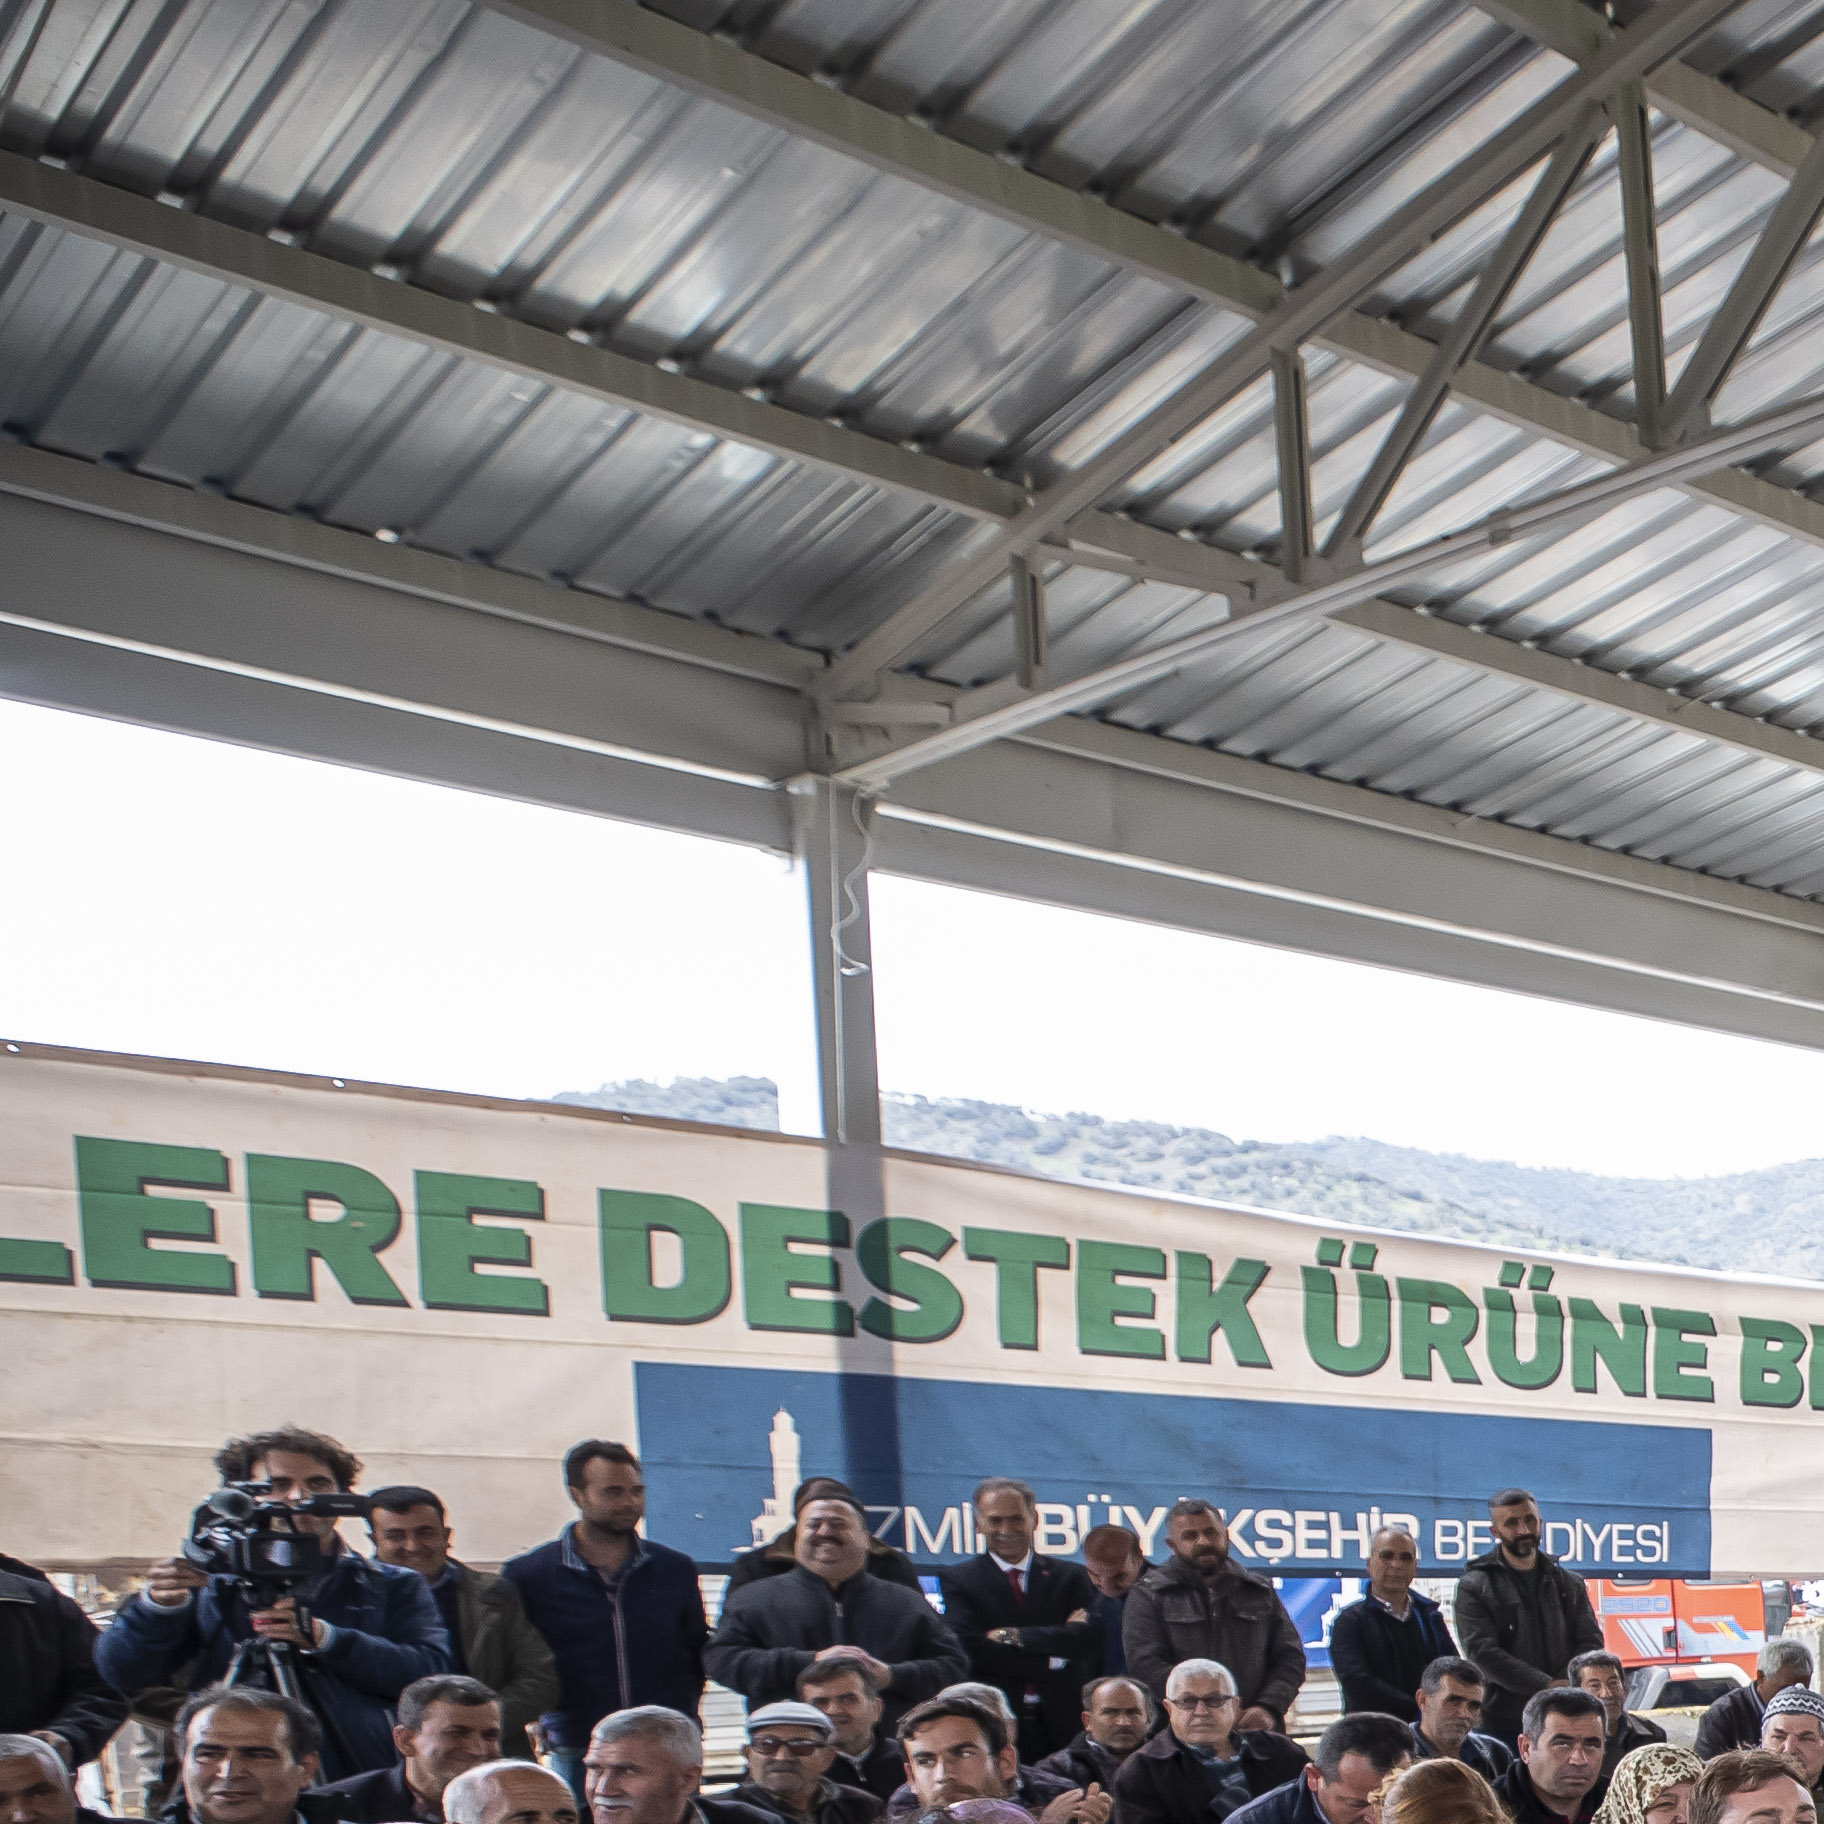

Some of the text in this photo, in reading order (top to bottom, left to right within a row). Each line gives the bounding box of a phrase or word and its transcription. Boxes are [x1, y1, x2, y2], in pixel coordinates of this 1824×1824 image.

[597, 1187, 1272, 1370] DESTEK
[1300, 1237, 1716, 1402] ÜRÜNE
[1435, 1518, 1669, 1563] BEDİYESİ
